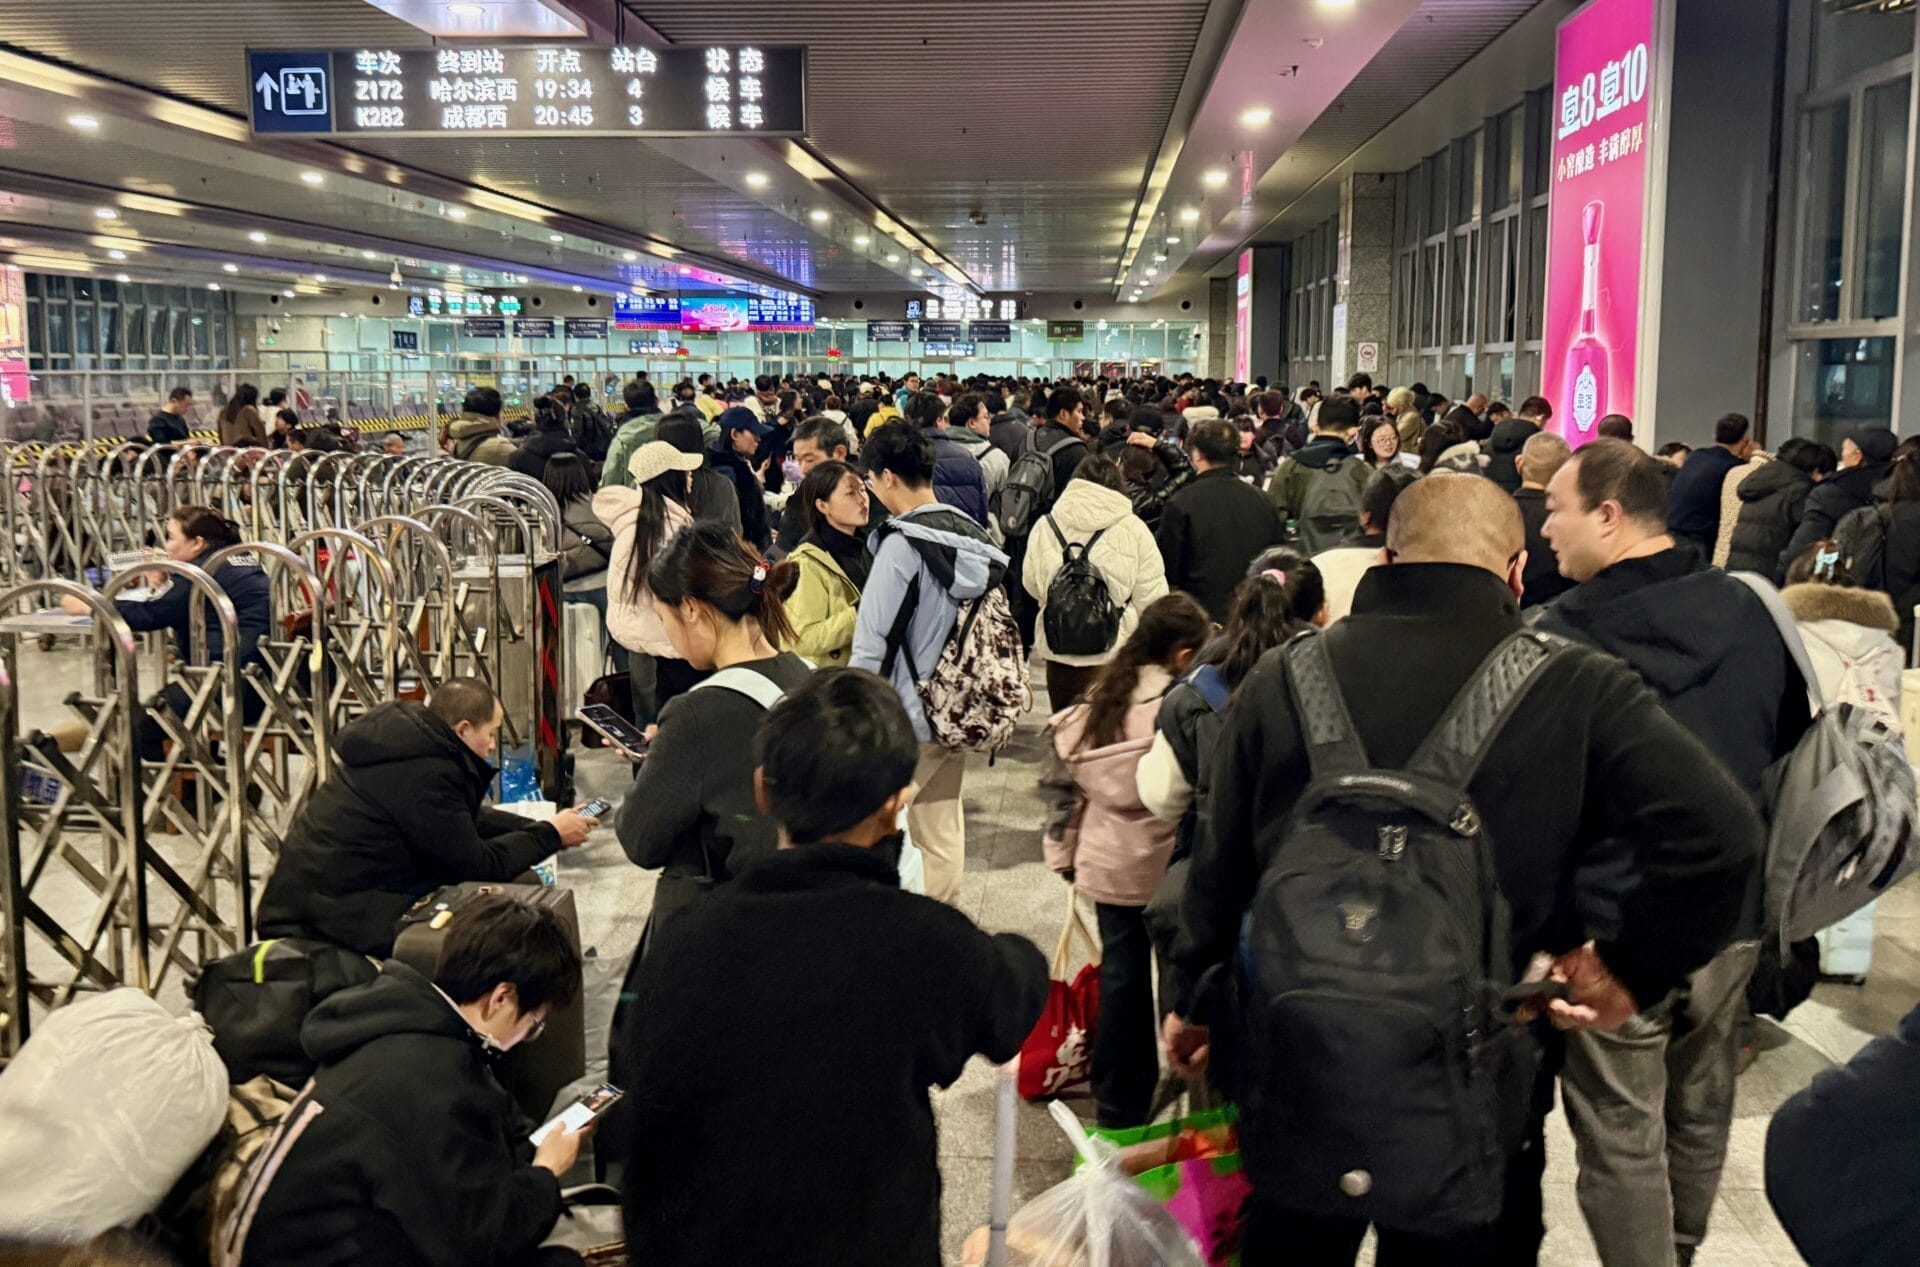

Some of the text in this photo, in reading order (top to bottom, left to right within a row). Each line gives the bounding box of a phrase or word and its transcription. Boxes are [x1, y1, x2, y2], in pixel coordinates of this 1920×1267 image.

[355, 50, 402, 75] 车次
[437, 48, 505, 74] 终到站
[536, 48, 582, 73] 开点
[611, 47, 657, 73] 站台
[355, 79, 404, 101] Z172
[429, 77, 518, 102] 哈尔滨西
[534, 78, 593, 99] 19:34
[627, 78, 643, 99] 4
[355, 106, 405, 127] K282
[441, 104, 508, 128] 成都西
[534, 105, 594, 126] 20:45
[628, 105, 644, 126] 3
